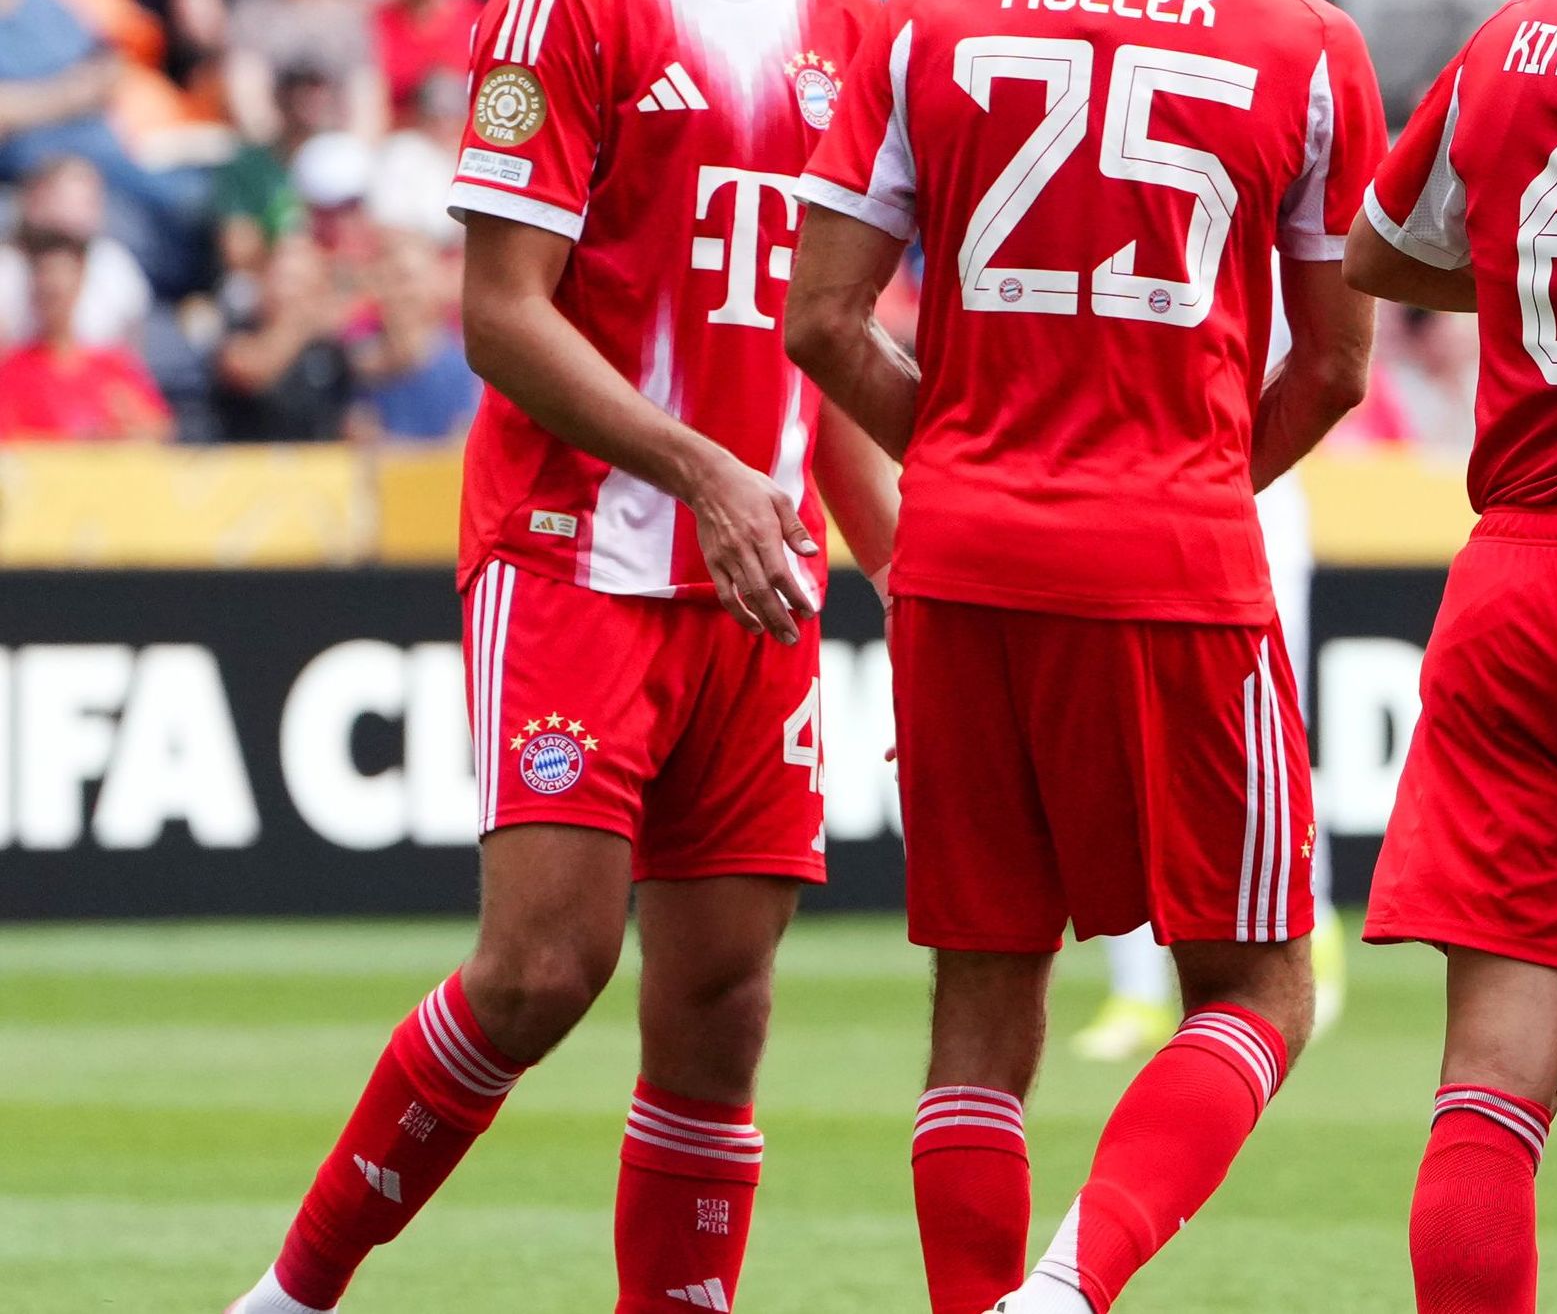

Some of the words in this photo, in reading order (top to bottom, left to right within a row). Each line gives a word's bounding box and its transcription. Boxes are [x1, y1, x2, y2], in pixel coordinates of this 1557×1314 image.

[483, 74, 516, 94] WORLD
[518, 77, 536, 94] CUP
[477, 96, 487, 123] CLUB
[519, 112, 538, 131] USA
[485, 125, 517, 142] FIFA
[952, 36, 1258, 328] 25
[0, 642, 263, 851] FA
[280, 638, 480, 852] CL
[783, 675, 825, 797] 4
[524, 745, 539, 761] FC
[538, 736, 579, 762] BAYERN
[696, 1198, 729, 1211] MIA
[696, 1218, 729, 1235] MIA
